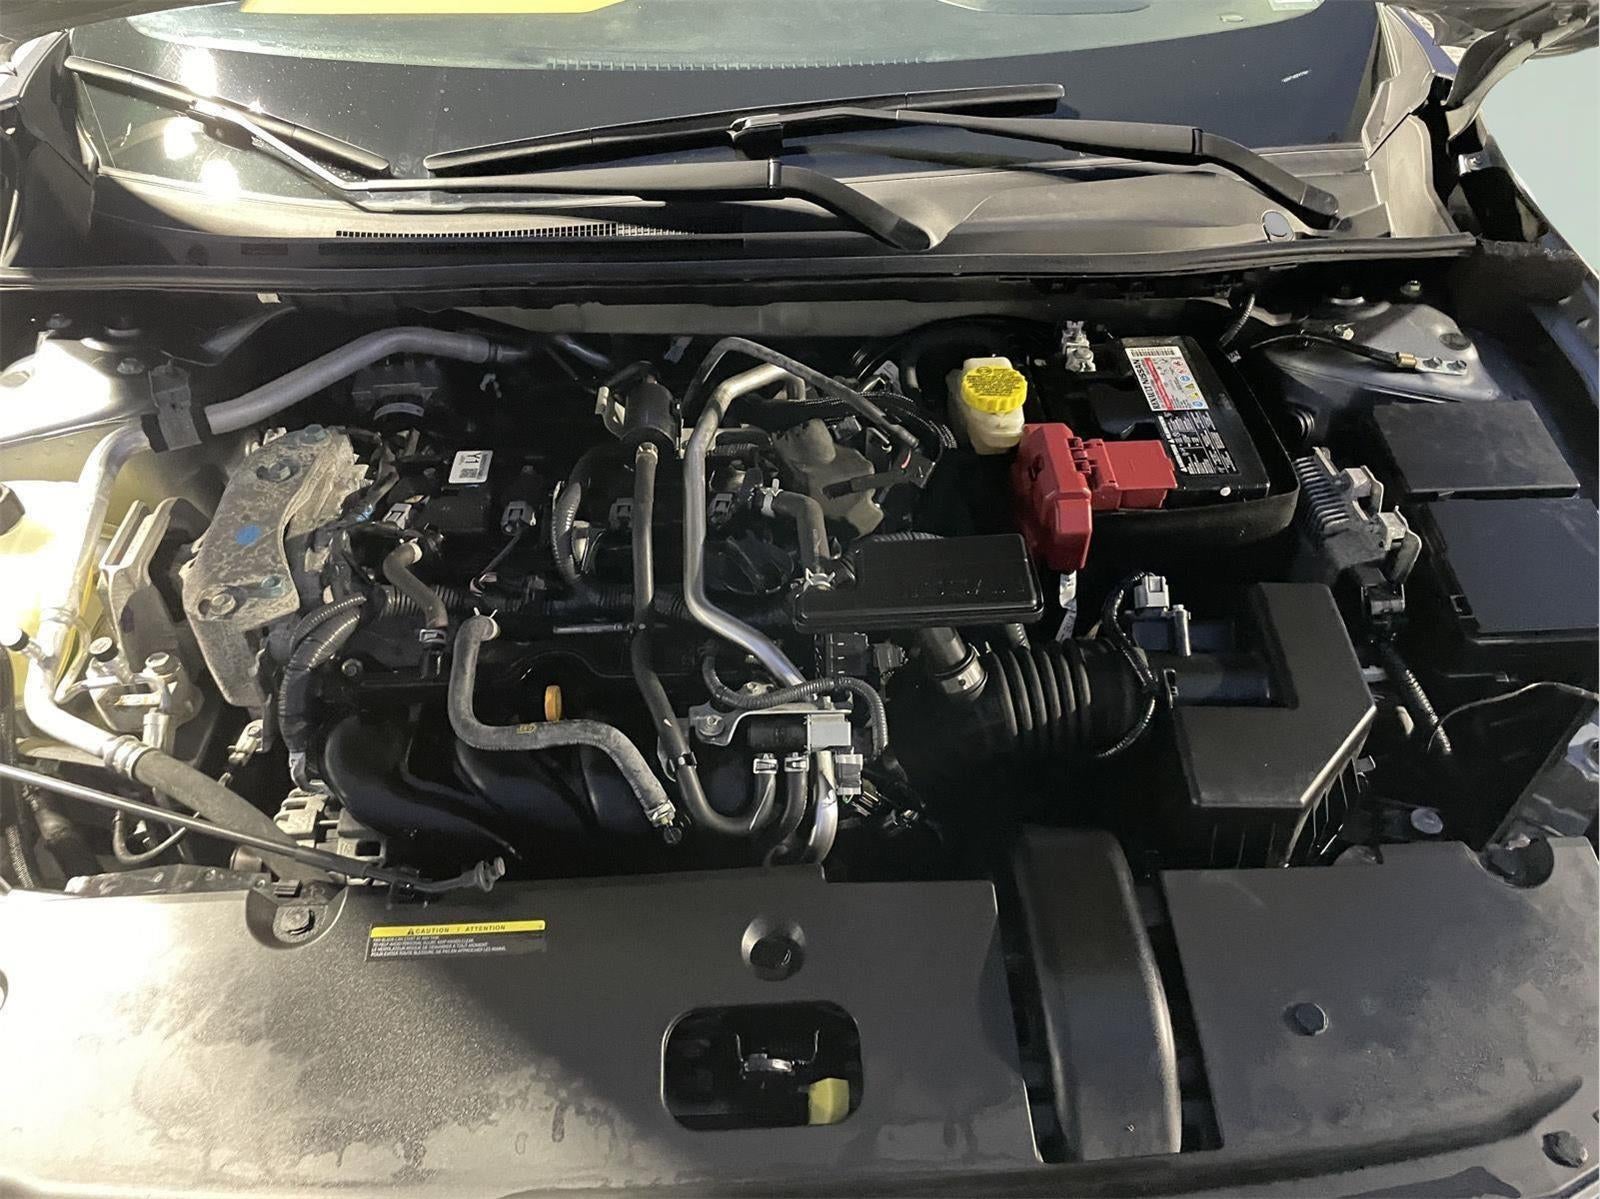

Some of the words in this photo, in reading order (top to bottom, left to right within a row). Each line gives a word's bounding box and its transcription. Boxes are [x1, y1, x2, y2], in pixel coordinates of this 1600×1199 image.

[1133, 359, 1150, 386] NISSAN
[466, 452, 481, 463] Y1
[465, 924, 507, 933] ATTENTION
